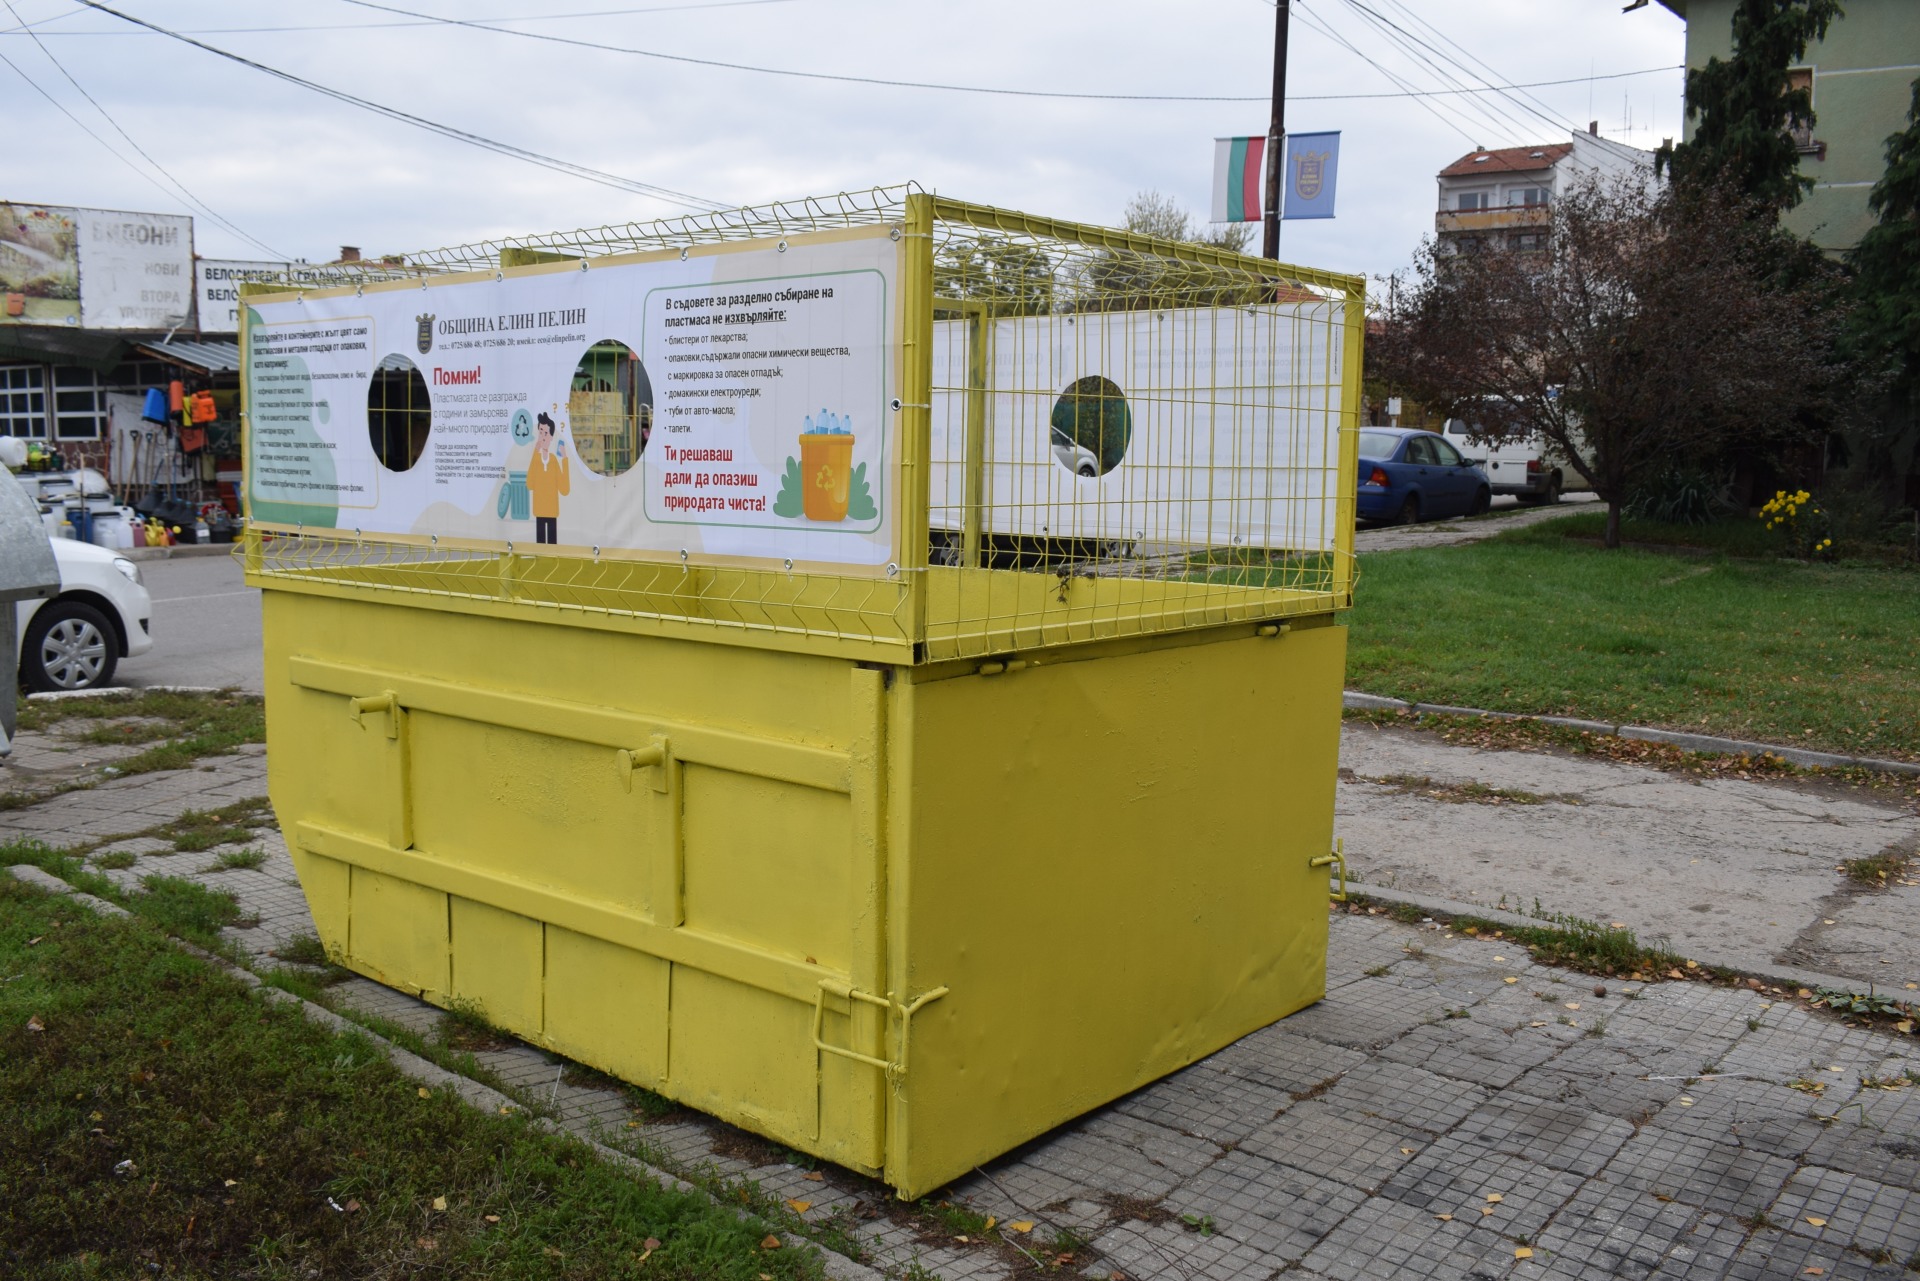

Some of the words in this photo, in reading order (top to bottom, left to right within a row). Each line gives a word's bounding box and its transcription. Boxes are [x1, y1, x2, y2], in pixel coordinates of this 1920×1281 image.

[145, 262, 180, 277] НОВИ
[141, 290, 181, 304] ВТОРА
[666, 297, 672, 310] В
[674, 296, 714, 311] съдовете
[716, 296, 727, 307] за
[728, 293, 772, 309] разделно
[774, 288, 820, 304] събиране
[821, 287, 833, 299] на
[439, 317, 495, 336] ОБЩИНА
[498, 313, 534, 331] ЕЛИН
[539, 308, 586, 327] ПЕЛИН
[665, 314, 710, 327] пластмаса
[712, 314, 723, 324] не
[724, 308, 787, 325] изхвърляйте:
[668, 335, 699, 346] блистери
[701, 335, 708, 344] от
[710, 332, 748, 345] лекарства;
[742, 349, 767, 360] опасни
[769, 348, 809, 359] химически
[810, 346, 850, 357] вещества,
[433, 365, 481, 386] Помни!
[667, 372, 672, 381] с
[673, 370, 714, 382] маркировка
[715, 370, 723, 378] за
[724, 369, 749, 379] опасен
[434, 392, 477, 404] Пластмасата
[479, 394, 487, 403] се
[488, 392, 527, 406] разгражда
[668, 388, 709, 400] домакински
[710, 387, 761, 399] електроуреди;
[434, 410, 437, 419] с
[439, 410, 462, 420] години
[464, 410, 468, 418] и
[469, 408, 508, 420] замърсява
[668, 406, 683, 416] туби
[684, 407, 692, 415] от
[693, 405, 735, 416] авто-масла;
[434, 423, 469, 434] най-много
[470, 422, 509, 436] природата!
[668, 424, 692, 434] тапети.
[664, 445, 677, 461] Ти
[680, 449, 733, 464] решаваш
[664, 472, 692, 487] дали
[694, 472, 710, 488] да
[712, 473, 758, 487] опазиш
[664, 495, 725, 512] природата
[728, 495, 766, 511] чиста!
